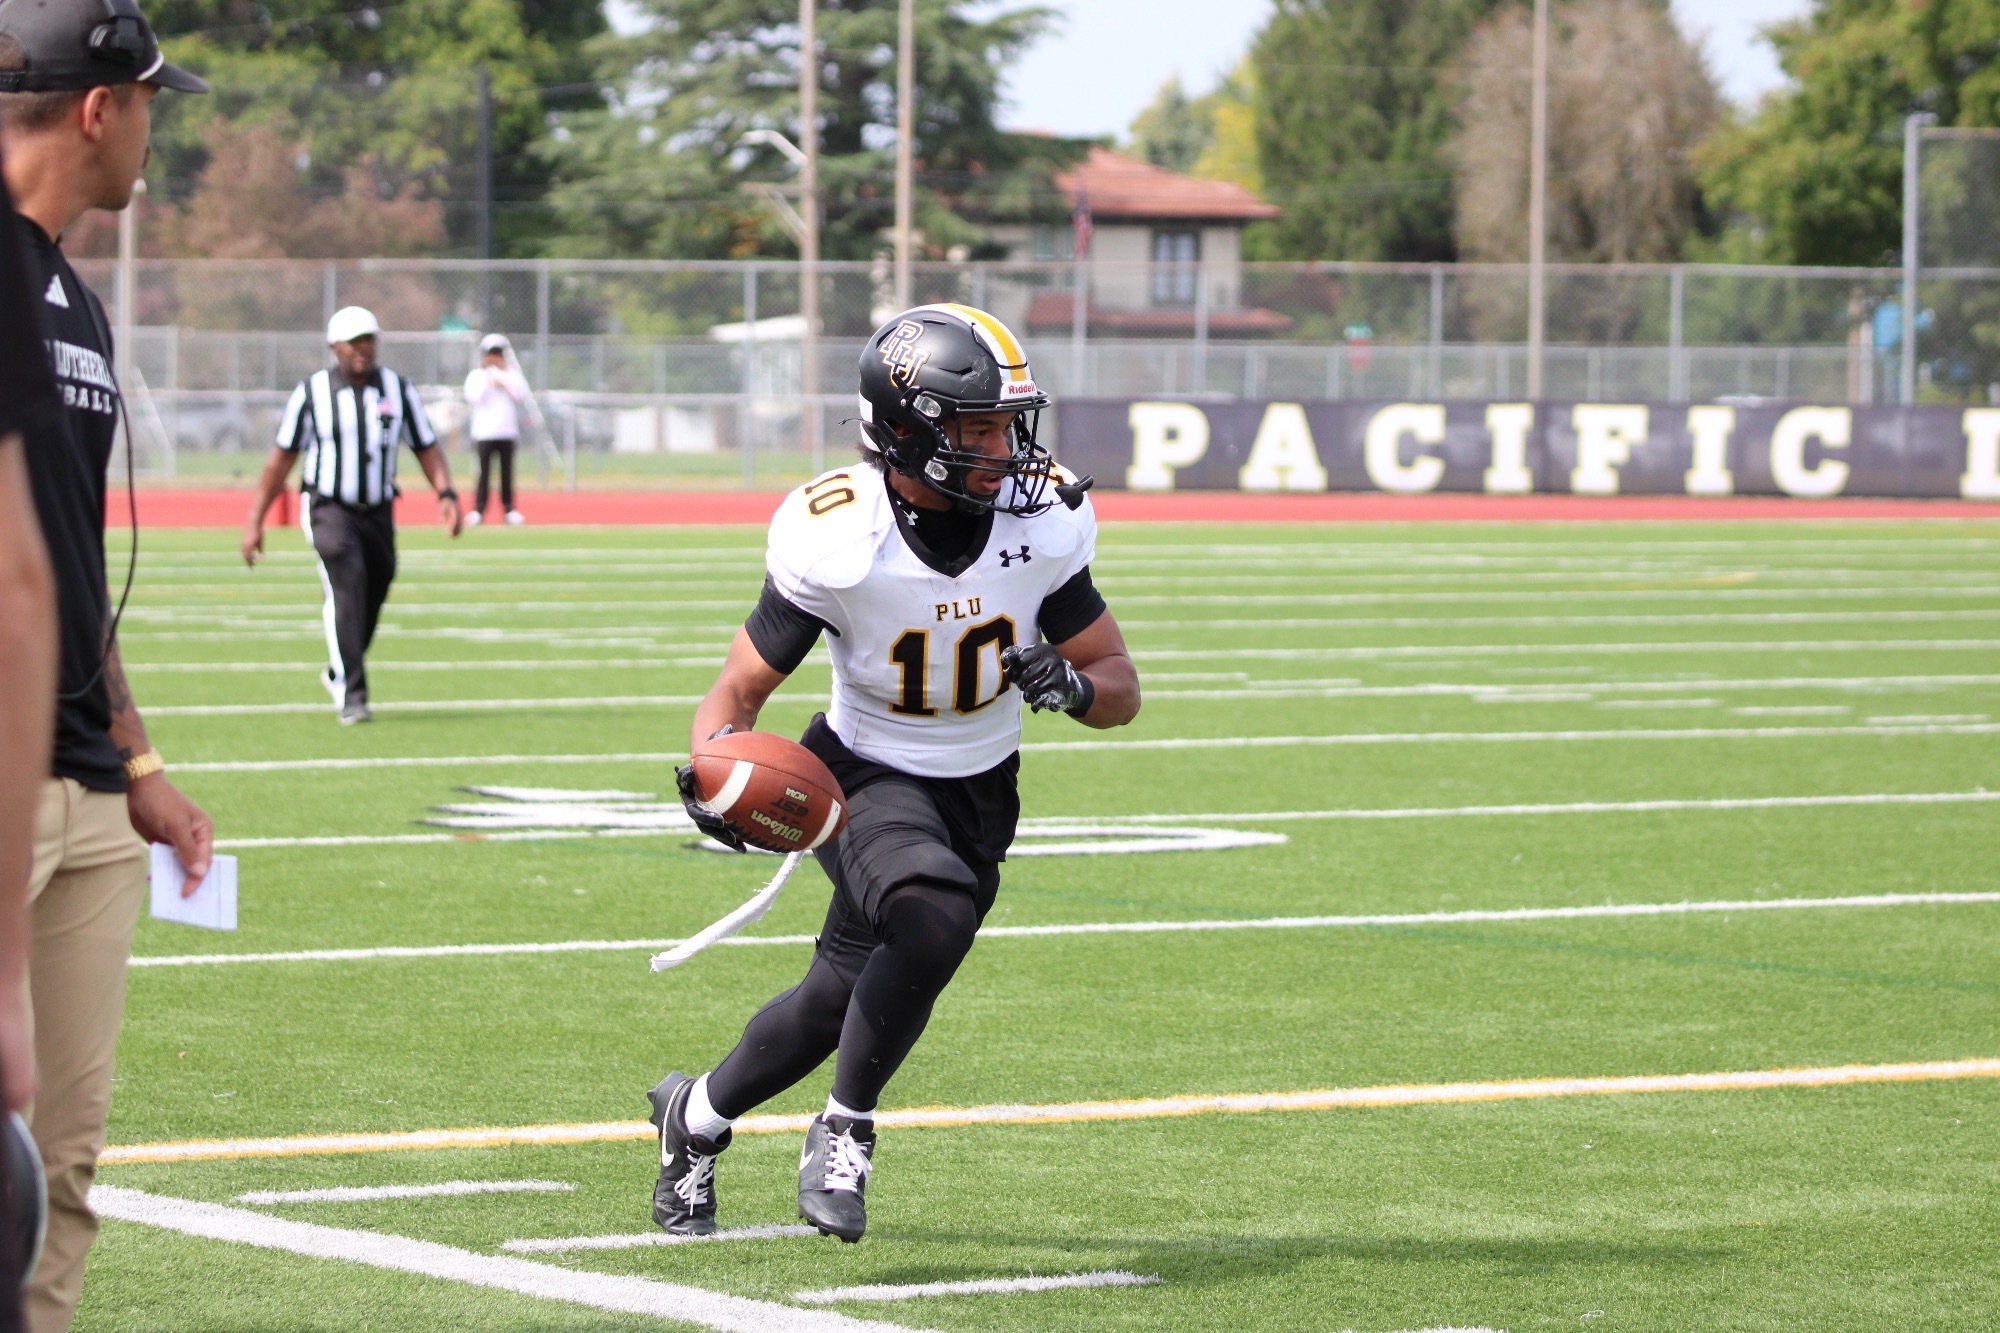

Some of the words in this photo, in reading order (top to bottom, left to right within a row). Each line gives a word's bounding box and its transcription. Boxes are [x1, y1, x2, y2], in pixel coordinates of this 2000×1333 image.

[880, 319, 931, 389] PLU
[57, 383, 112, 414] BALL
[1008, 383, 1036, 395] Riddell
[1126, 402, 1852, 496] PACIFIC
[804, 473, 857, 517] 10
[935, 597, 982, 621] PLU
[888, 613, 1017, 717] 10
[770, 797, 809, 817] GST
[785, 786, 808, 802] NCAA
[750, 809, 804, 842] Wilson
